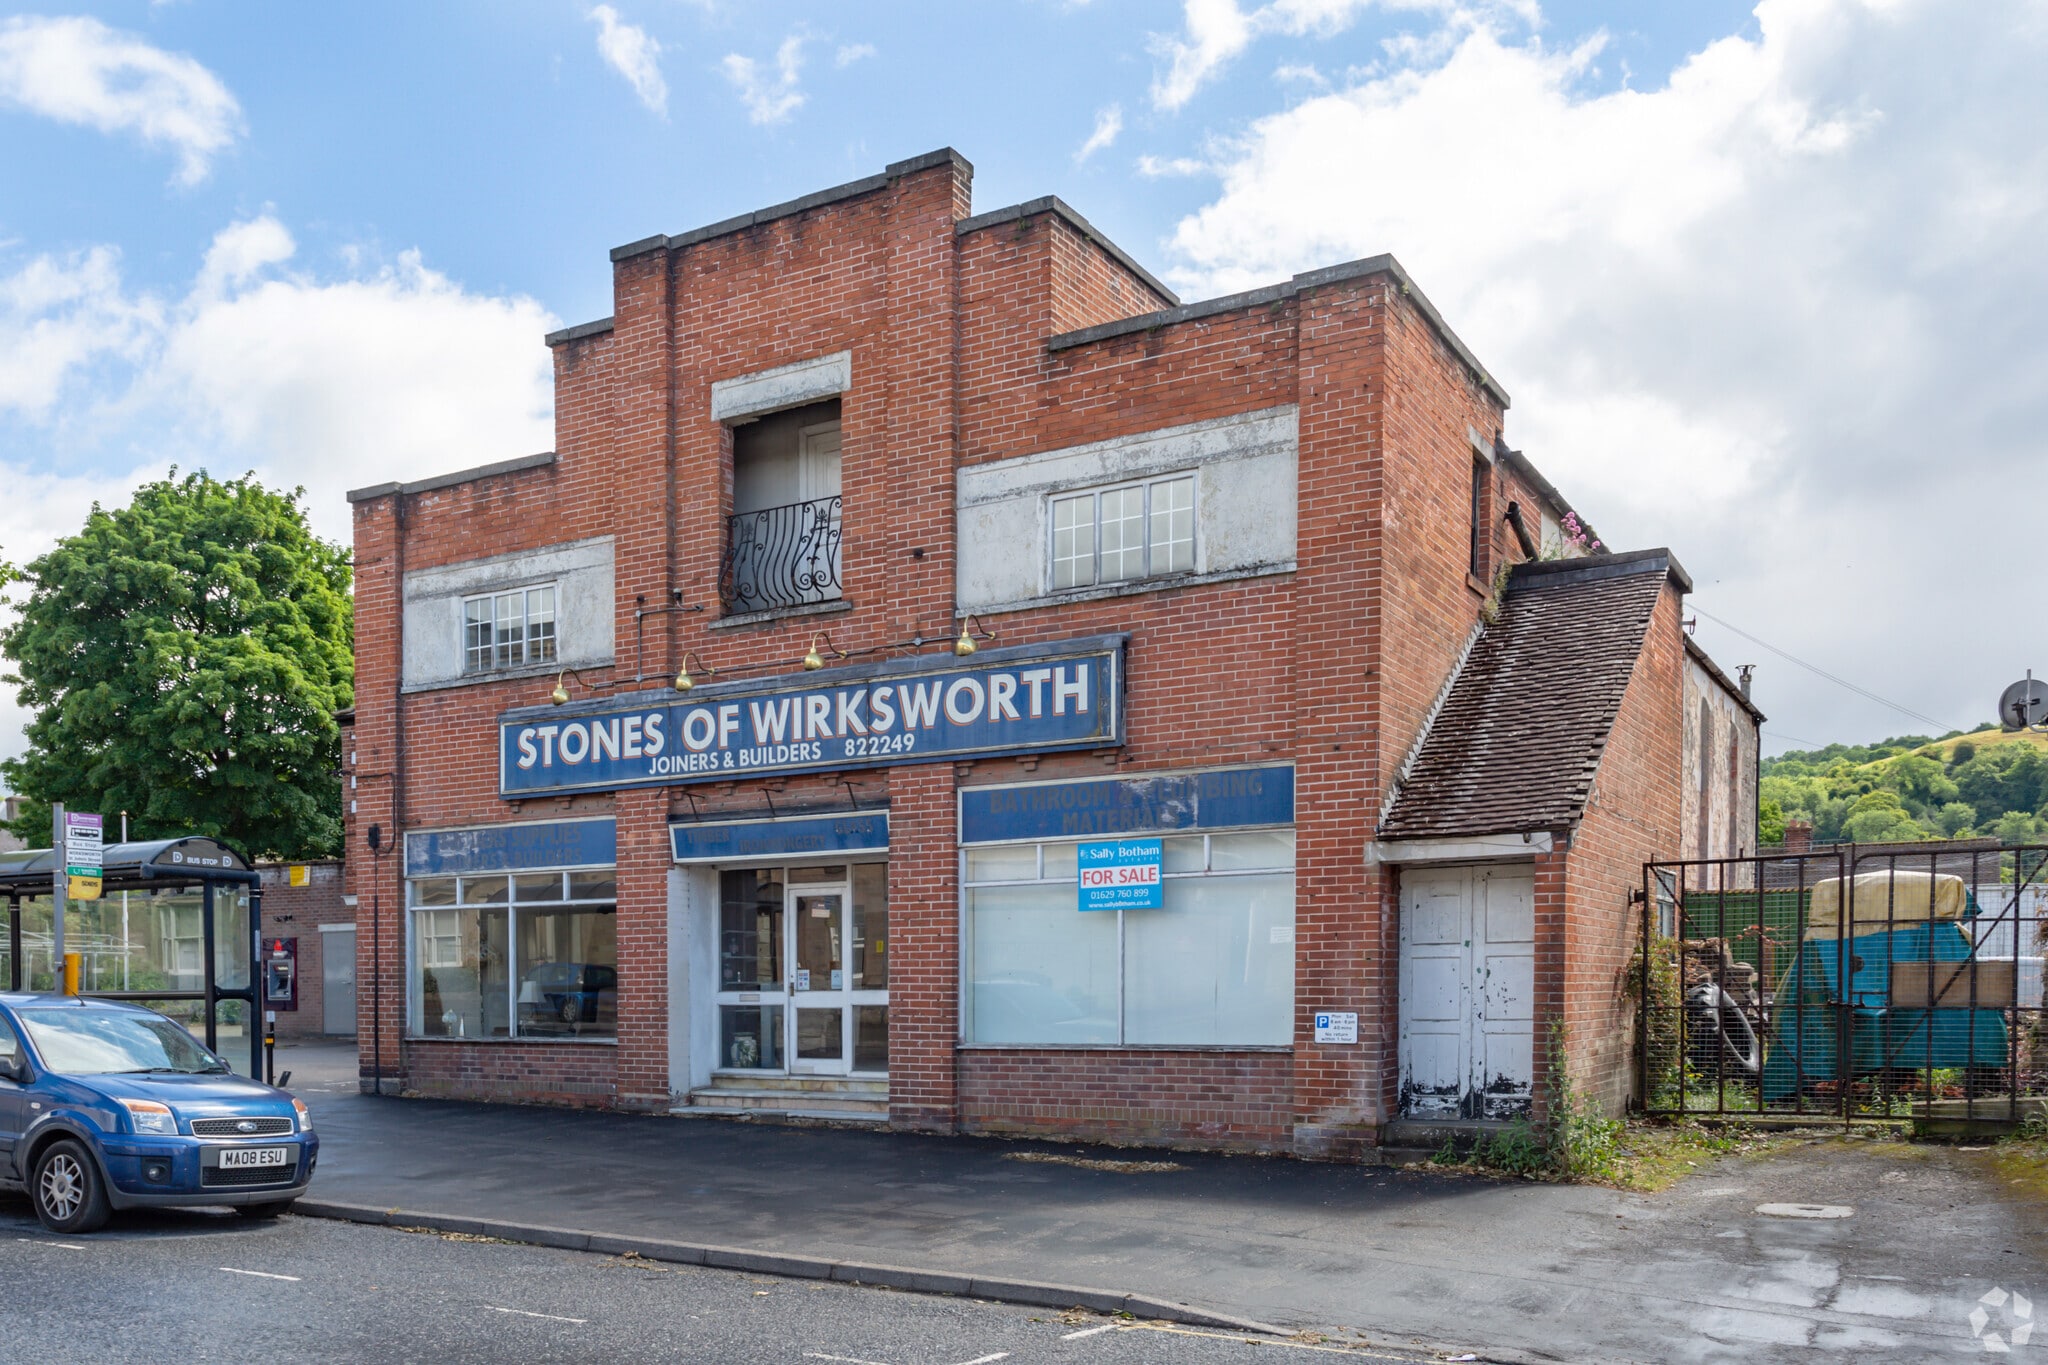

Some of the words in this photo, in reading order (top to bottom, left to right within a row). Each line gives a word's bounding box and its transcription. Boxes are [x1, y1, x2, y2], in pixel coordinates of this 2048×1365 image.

[517, 712, 665, 770] STONES
[682, 703, 740, 753] OF
[749, 663, 1089, 746] WIRKSWORTH
[649, 752, 718, 775] JOINERS
[723, 752, 735, 768] &
[739, 740, 822, 767] BUILDERS
[844, 733, 915, 757] 822249
[990, 780, 1111, 814] BATHROOM
[187, 856, 200, 864] BUS
[202, 857, 218, 865] STOP
[1090, 847, 1115, 860] Sally
[1118, 846, 1159, 857] Botham
[1082, 869, 1114, 886] FOR
[1119, 866, 1157, 884] SALE
[1090, 890, 1115, 900] 01629
[1117, 889, 1132, 898] 760
[1133, 888, 1149, 897] 899
[1319, 1017, 1328, 1027] P
[225, 1151, 257, 1165] MA08
[260, 1150, 282, 1164] ESU
